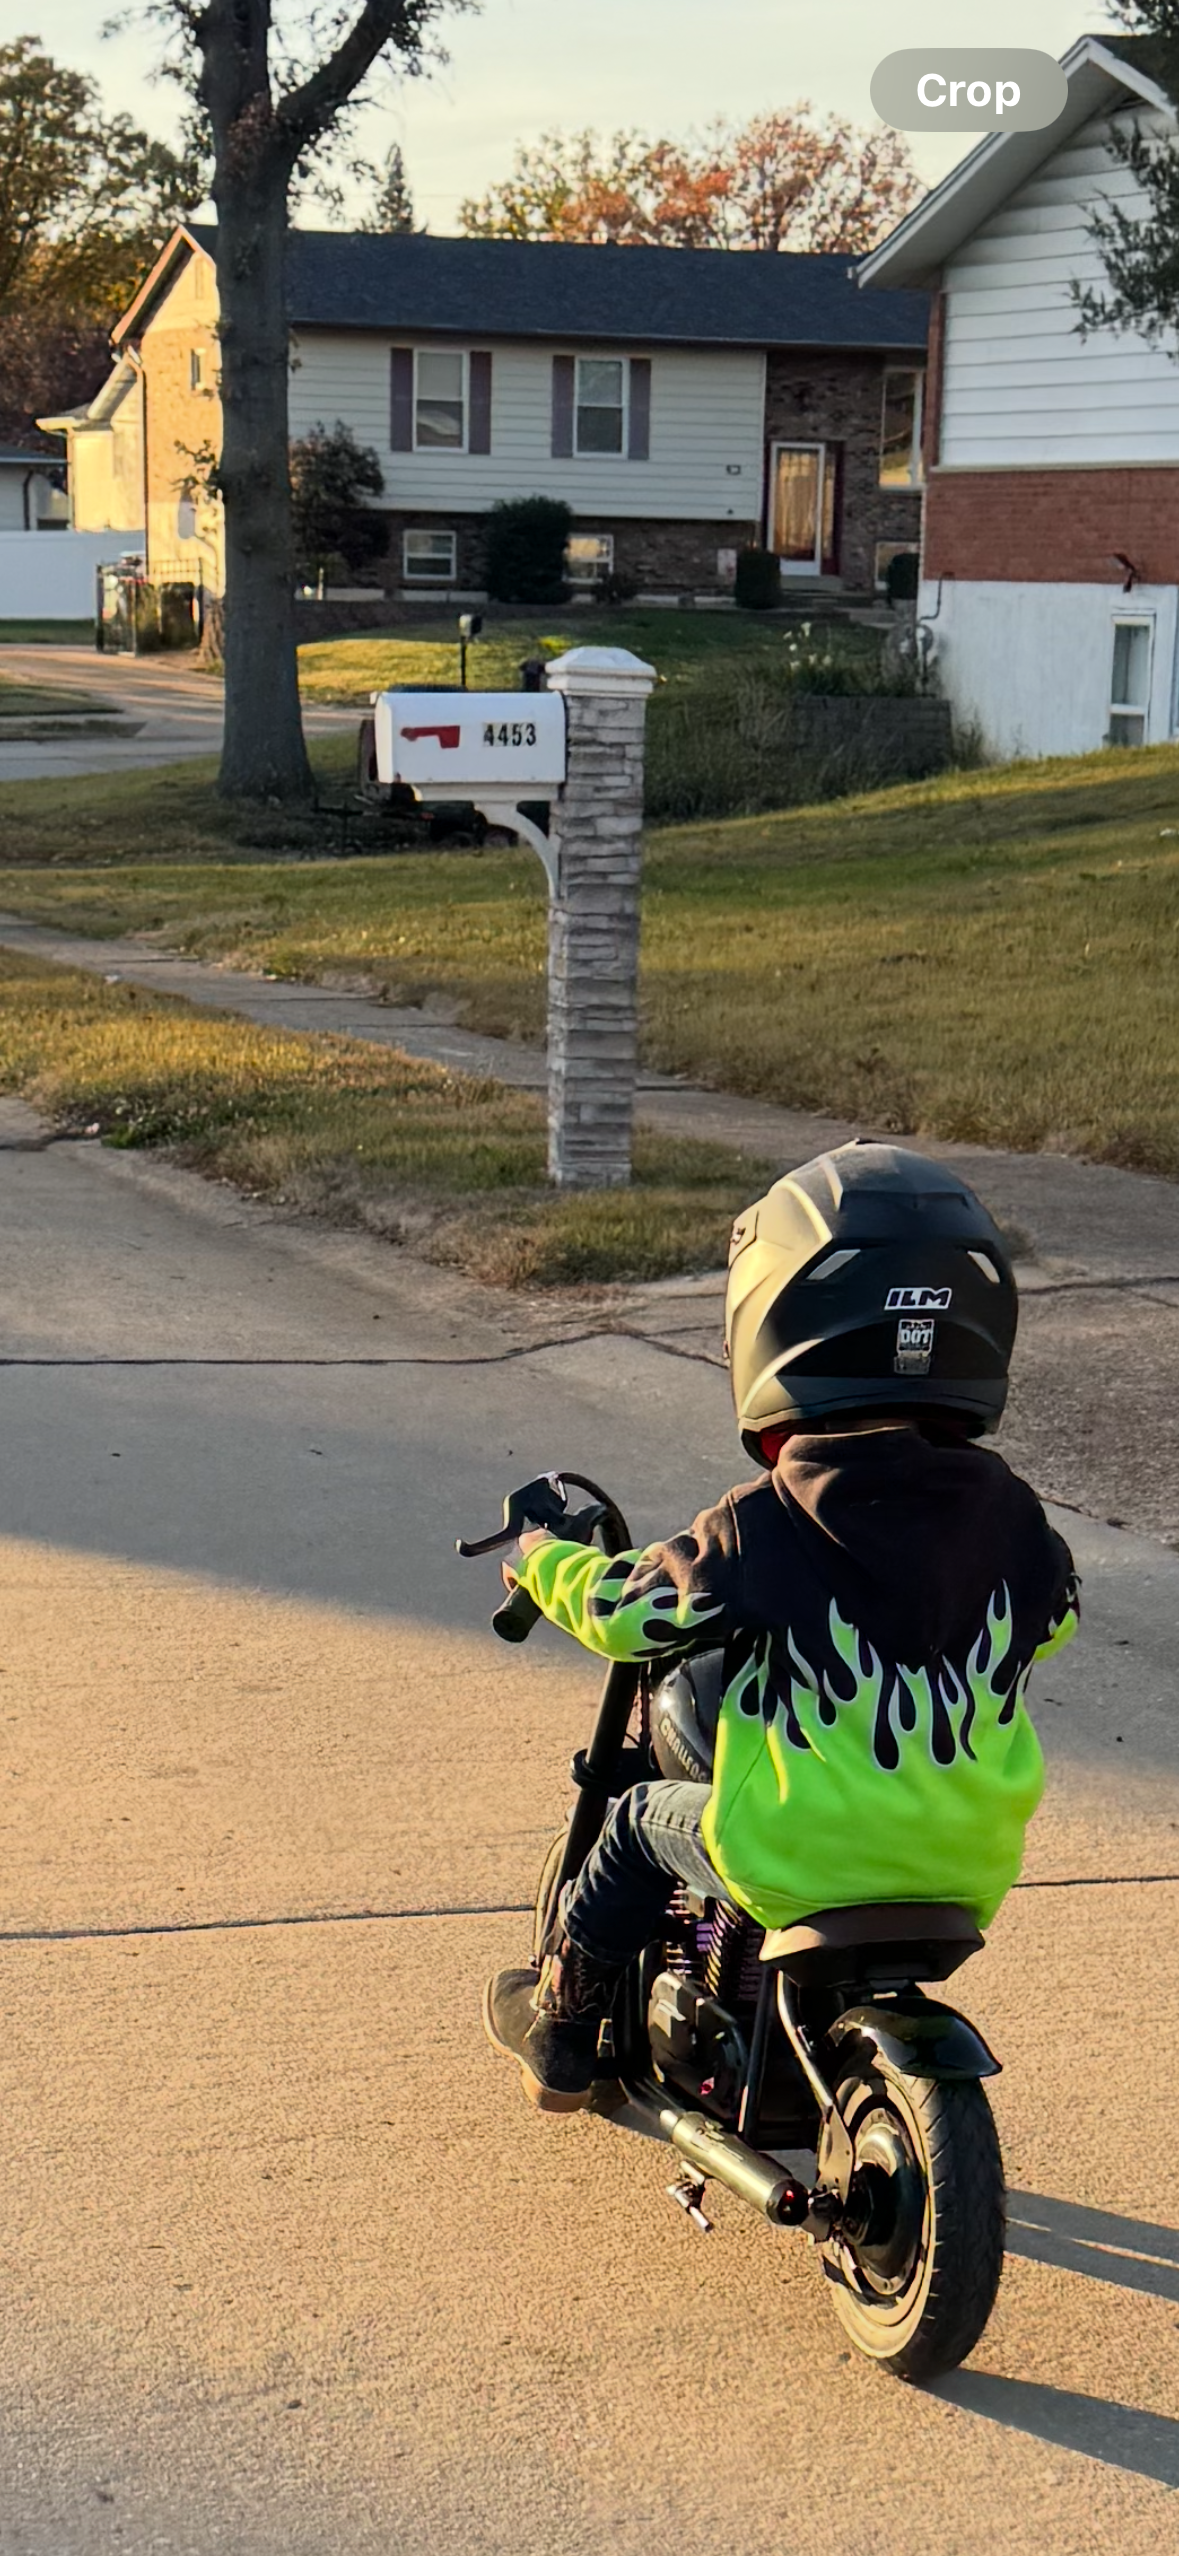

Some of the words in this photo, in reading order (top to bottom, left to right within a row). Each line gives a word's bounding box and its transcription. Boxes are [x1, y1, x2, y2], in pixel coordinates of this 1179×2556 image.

[483, 723, 537, 747] 4453
[885, 1287, 952, 1309] ILM
[900, 1329, 931, 1344] DOT
